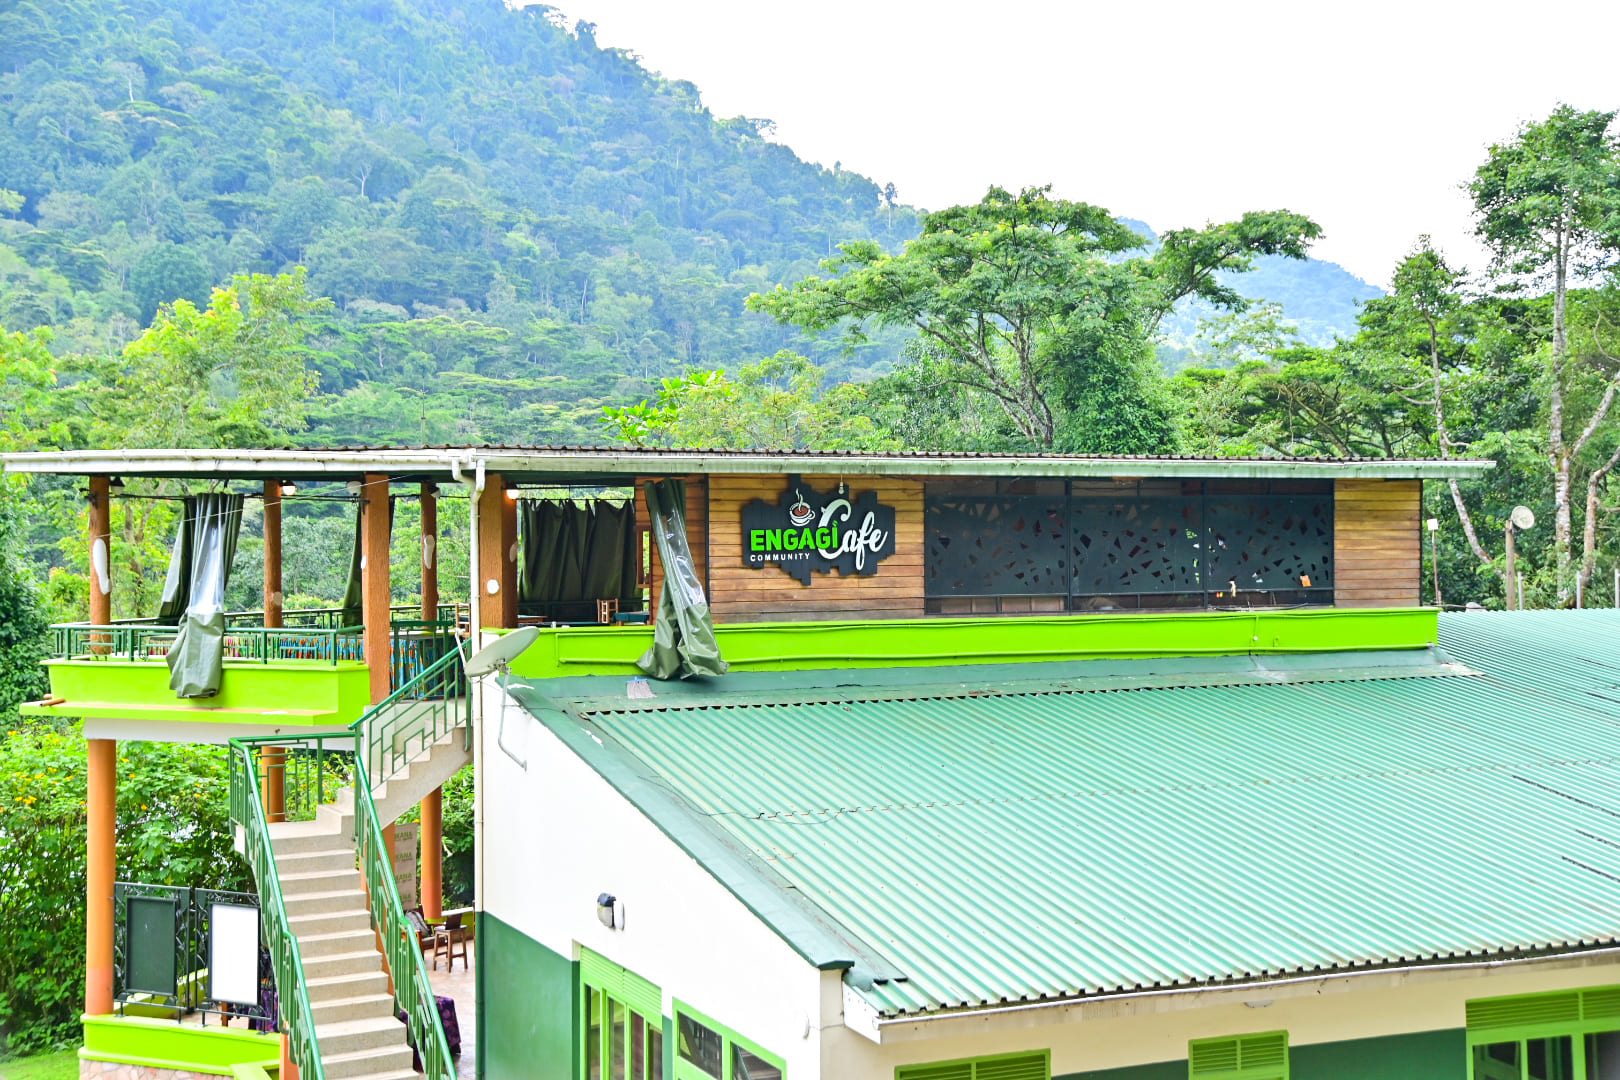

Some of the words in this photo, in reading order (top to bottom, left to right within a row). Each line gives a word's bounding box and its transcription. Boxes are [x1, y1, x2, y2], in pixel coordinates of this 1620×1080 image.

[751, 521, 839, 551] ENGAGI
[818, 499, 888, 571] Cafe
[750, 552, 810, 562] COMMUNITY
